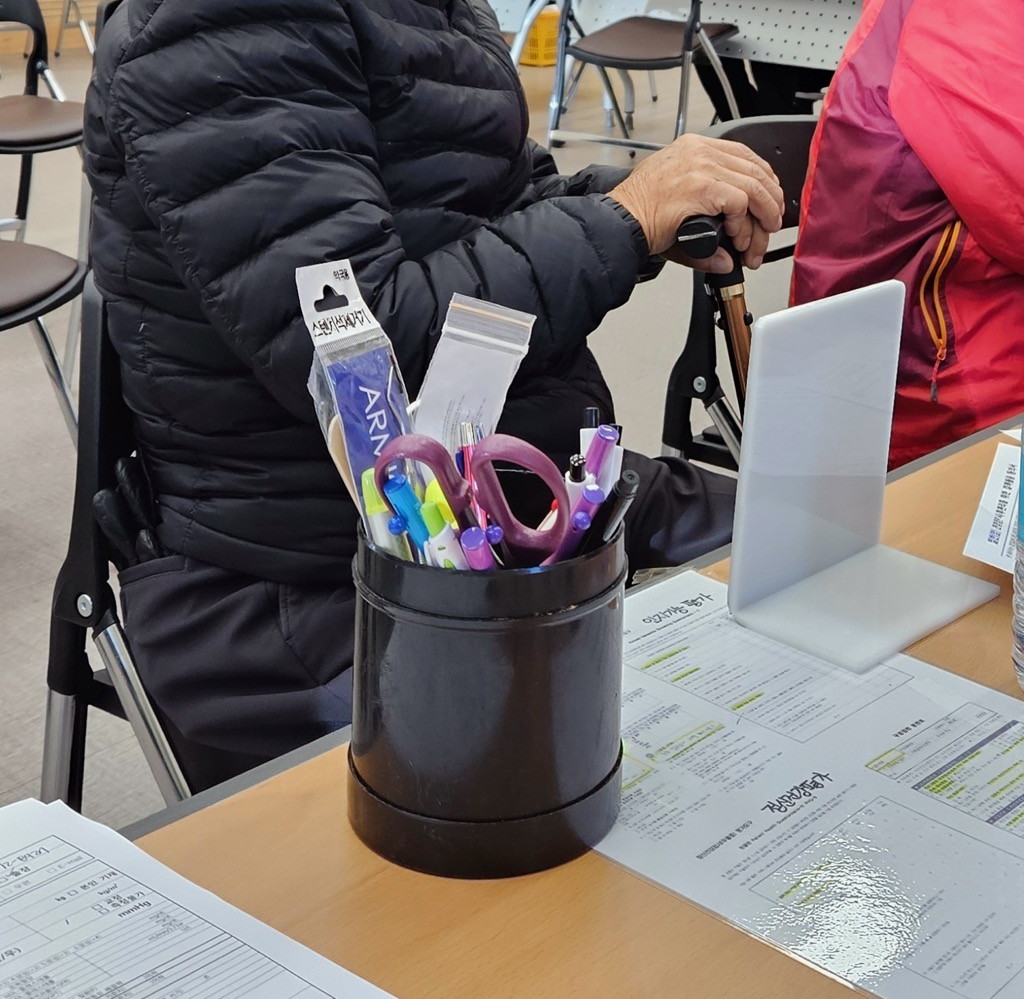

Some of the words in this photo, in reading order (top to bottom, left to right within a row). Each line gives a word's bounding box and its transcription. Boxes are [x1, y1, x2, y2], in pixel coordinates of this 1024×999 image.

[333, 268, 350, 280] 약국용
[312, 308, 371, 337] 스텐치석제거기
[642, 605, 688, 624] 인지기능
[680, 592, 714, 608] 평가
[761, 772, 833, 813] 정신건강평가
[80, 880, 98, 891] 본인
[100, 870, 119, 882] 기재
[117, 899, 152, 919] mmHg
